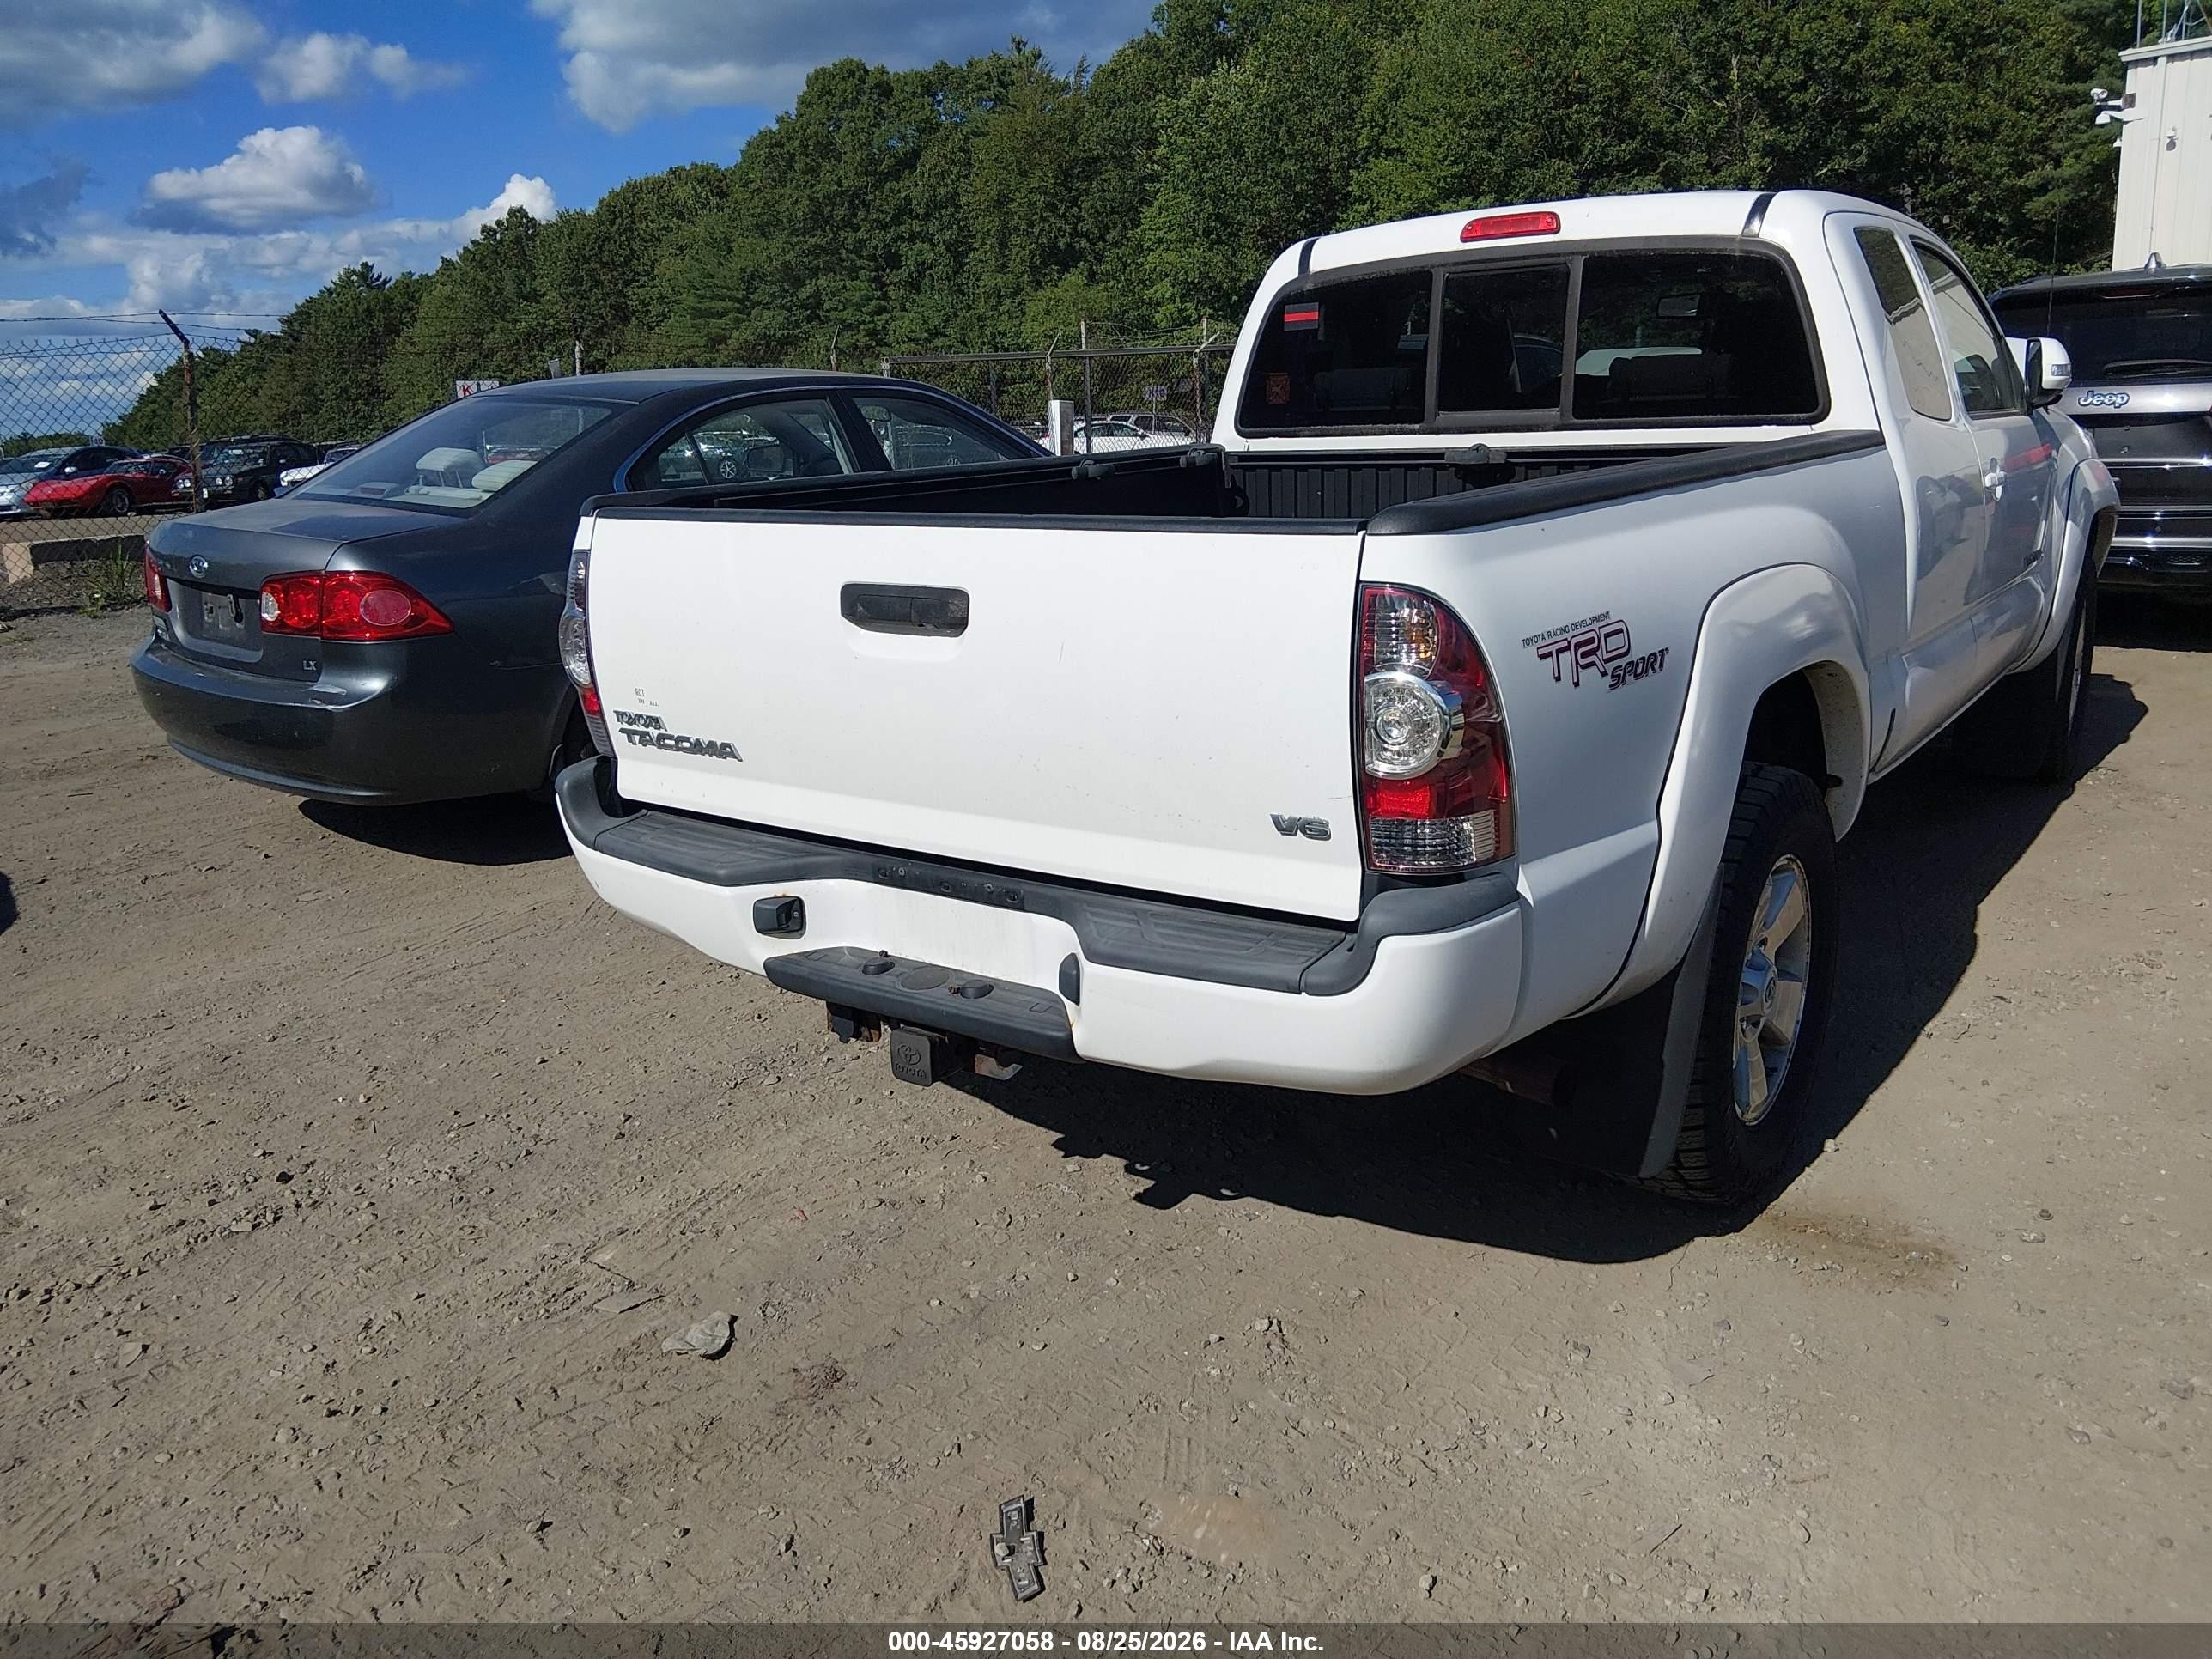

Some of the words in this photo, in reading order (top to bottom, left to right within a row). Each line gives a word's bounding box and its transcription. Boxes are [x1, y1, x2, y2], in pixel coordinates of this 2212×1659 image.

[2078, 390, 2130, 409] Jeep
[1522, 631, 1547, 647] TOYOTA
[1547, 624, 1571, 639] RACING
[1571, 611, 1611, 632] DEVELOPMENT
[302, 660, 317, 671] LX
[1536, 619, 1632, 688] TRD
[1608, 647, 1669, 690] SPORT
[618, 727, 744, 763] TACOMA
[1269, 813, 1332, 842] V6
